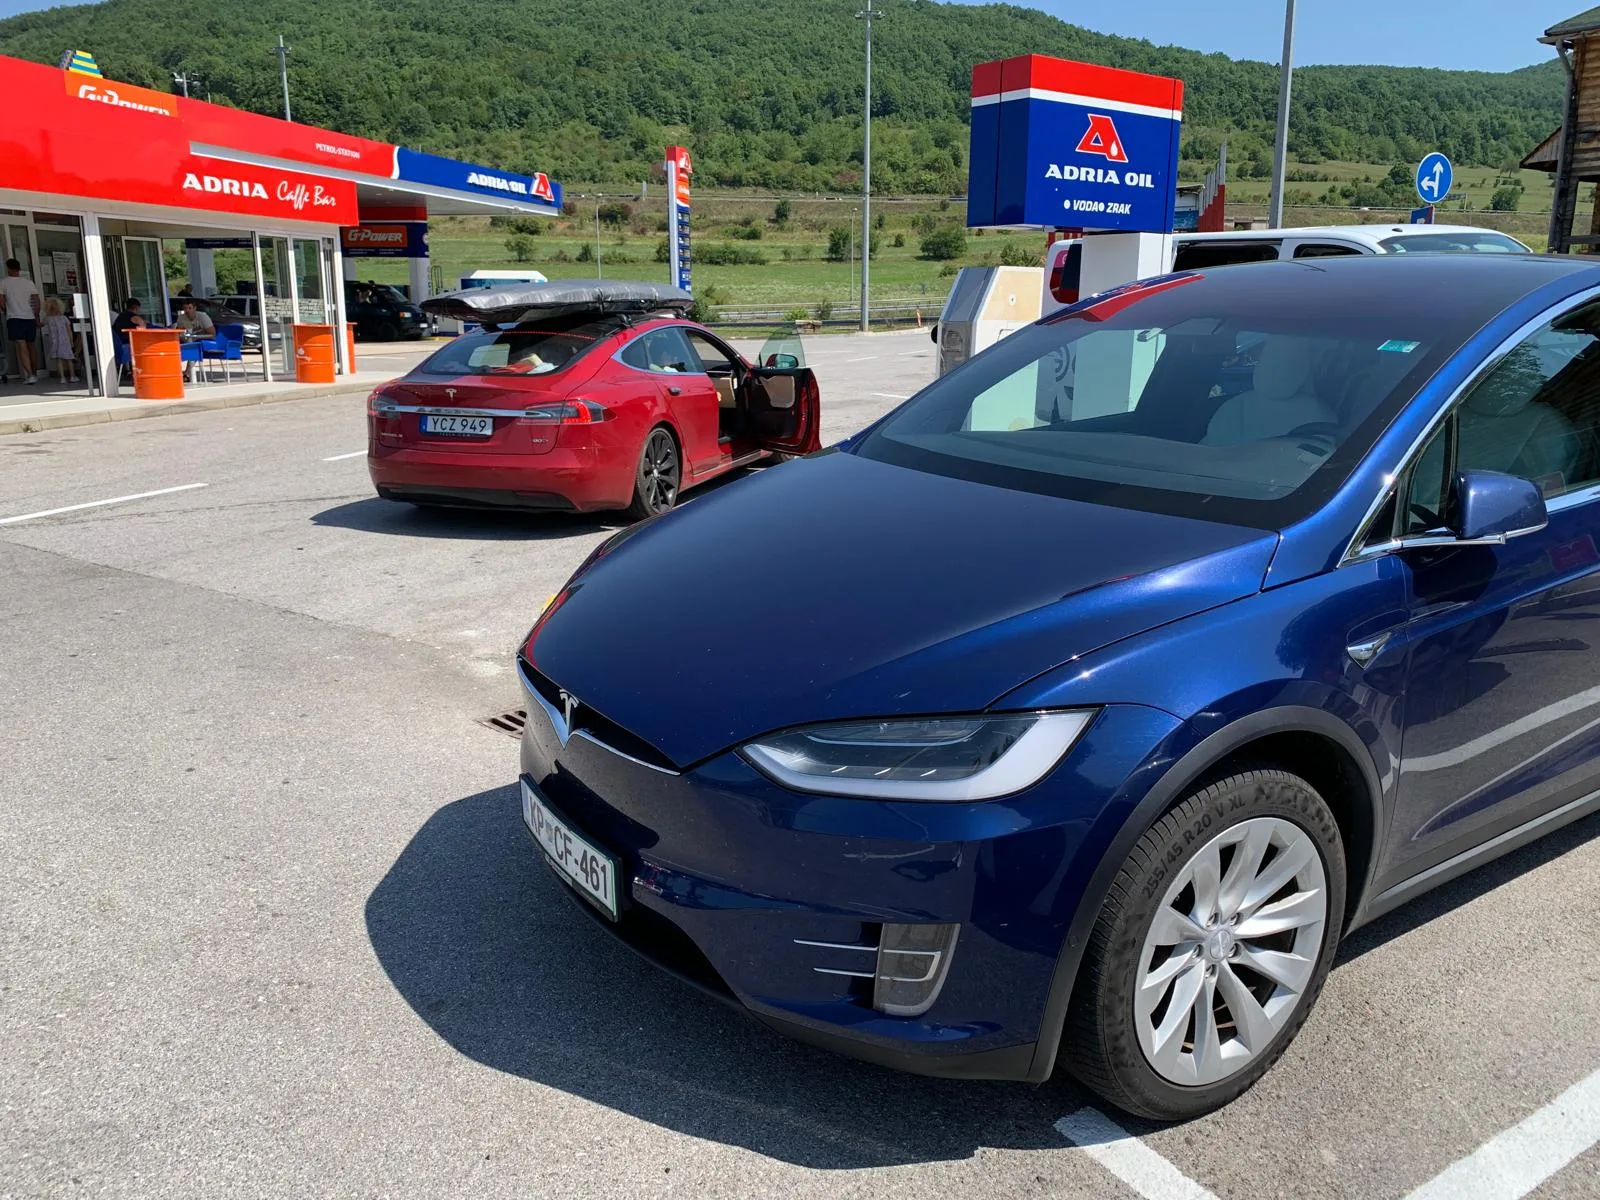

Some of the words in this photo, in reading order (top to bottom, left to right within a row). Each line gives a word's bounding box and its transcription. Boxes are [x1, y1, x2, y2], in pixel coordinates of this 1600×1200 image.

[466, 171, 509, 191] ADRIA
[508, 181, 528, 194] OIL
[1044, 163, 1120, 184] ADRIA
[1124, 172, 1154, 188] OIL
[182, 173, 269, 199] ADRIA
[276, 180, 310, 211] Caffe
[313, 185, 336, 207] Bar
[1073, 199, 1099, 212] VODA
[1105, 202, 1132, 215] ZRAK
[432, 417, 456, 432] YCZ
[460, 418, 487, 433] 949
[529, 796, 544, 836] KP
[553, 825, 608, 900] CF-461
[1142, 842, 1183, 899] 255/45
[1215, 803, 1224, 818] V
[1228, 794, 1245, 811] XL
